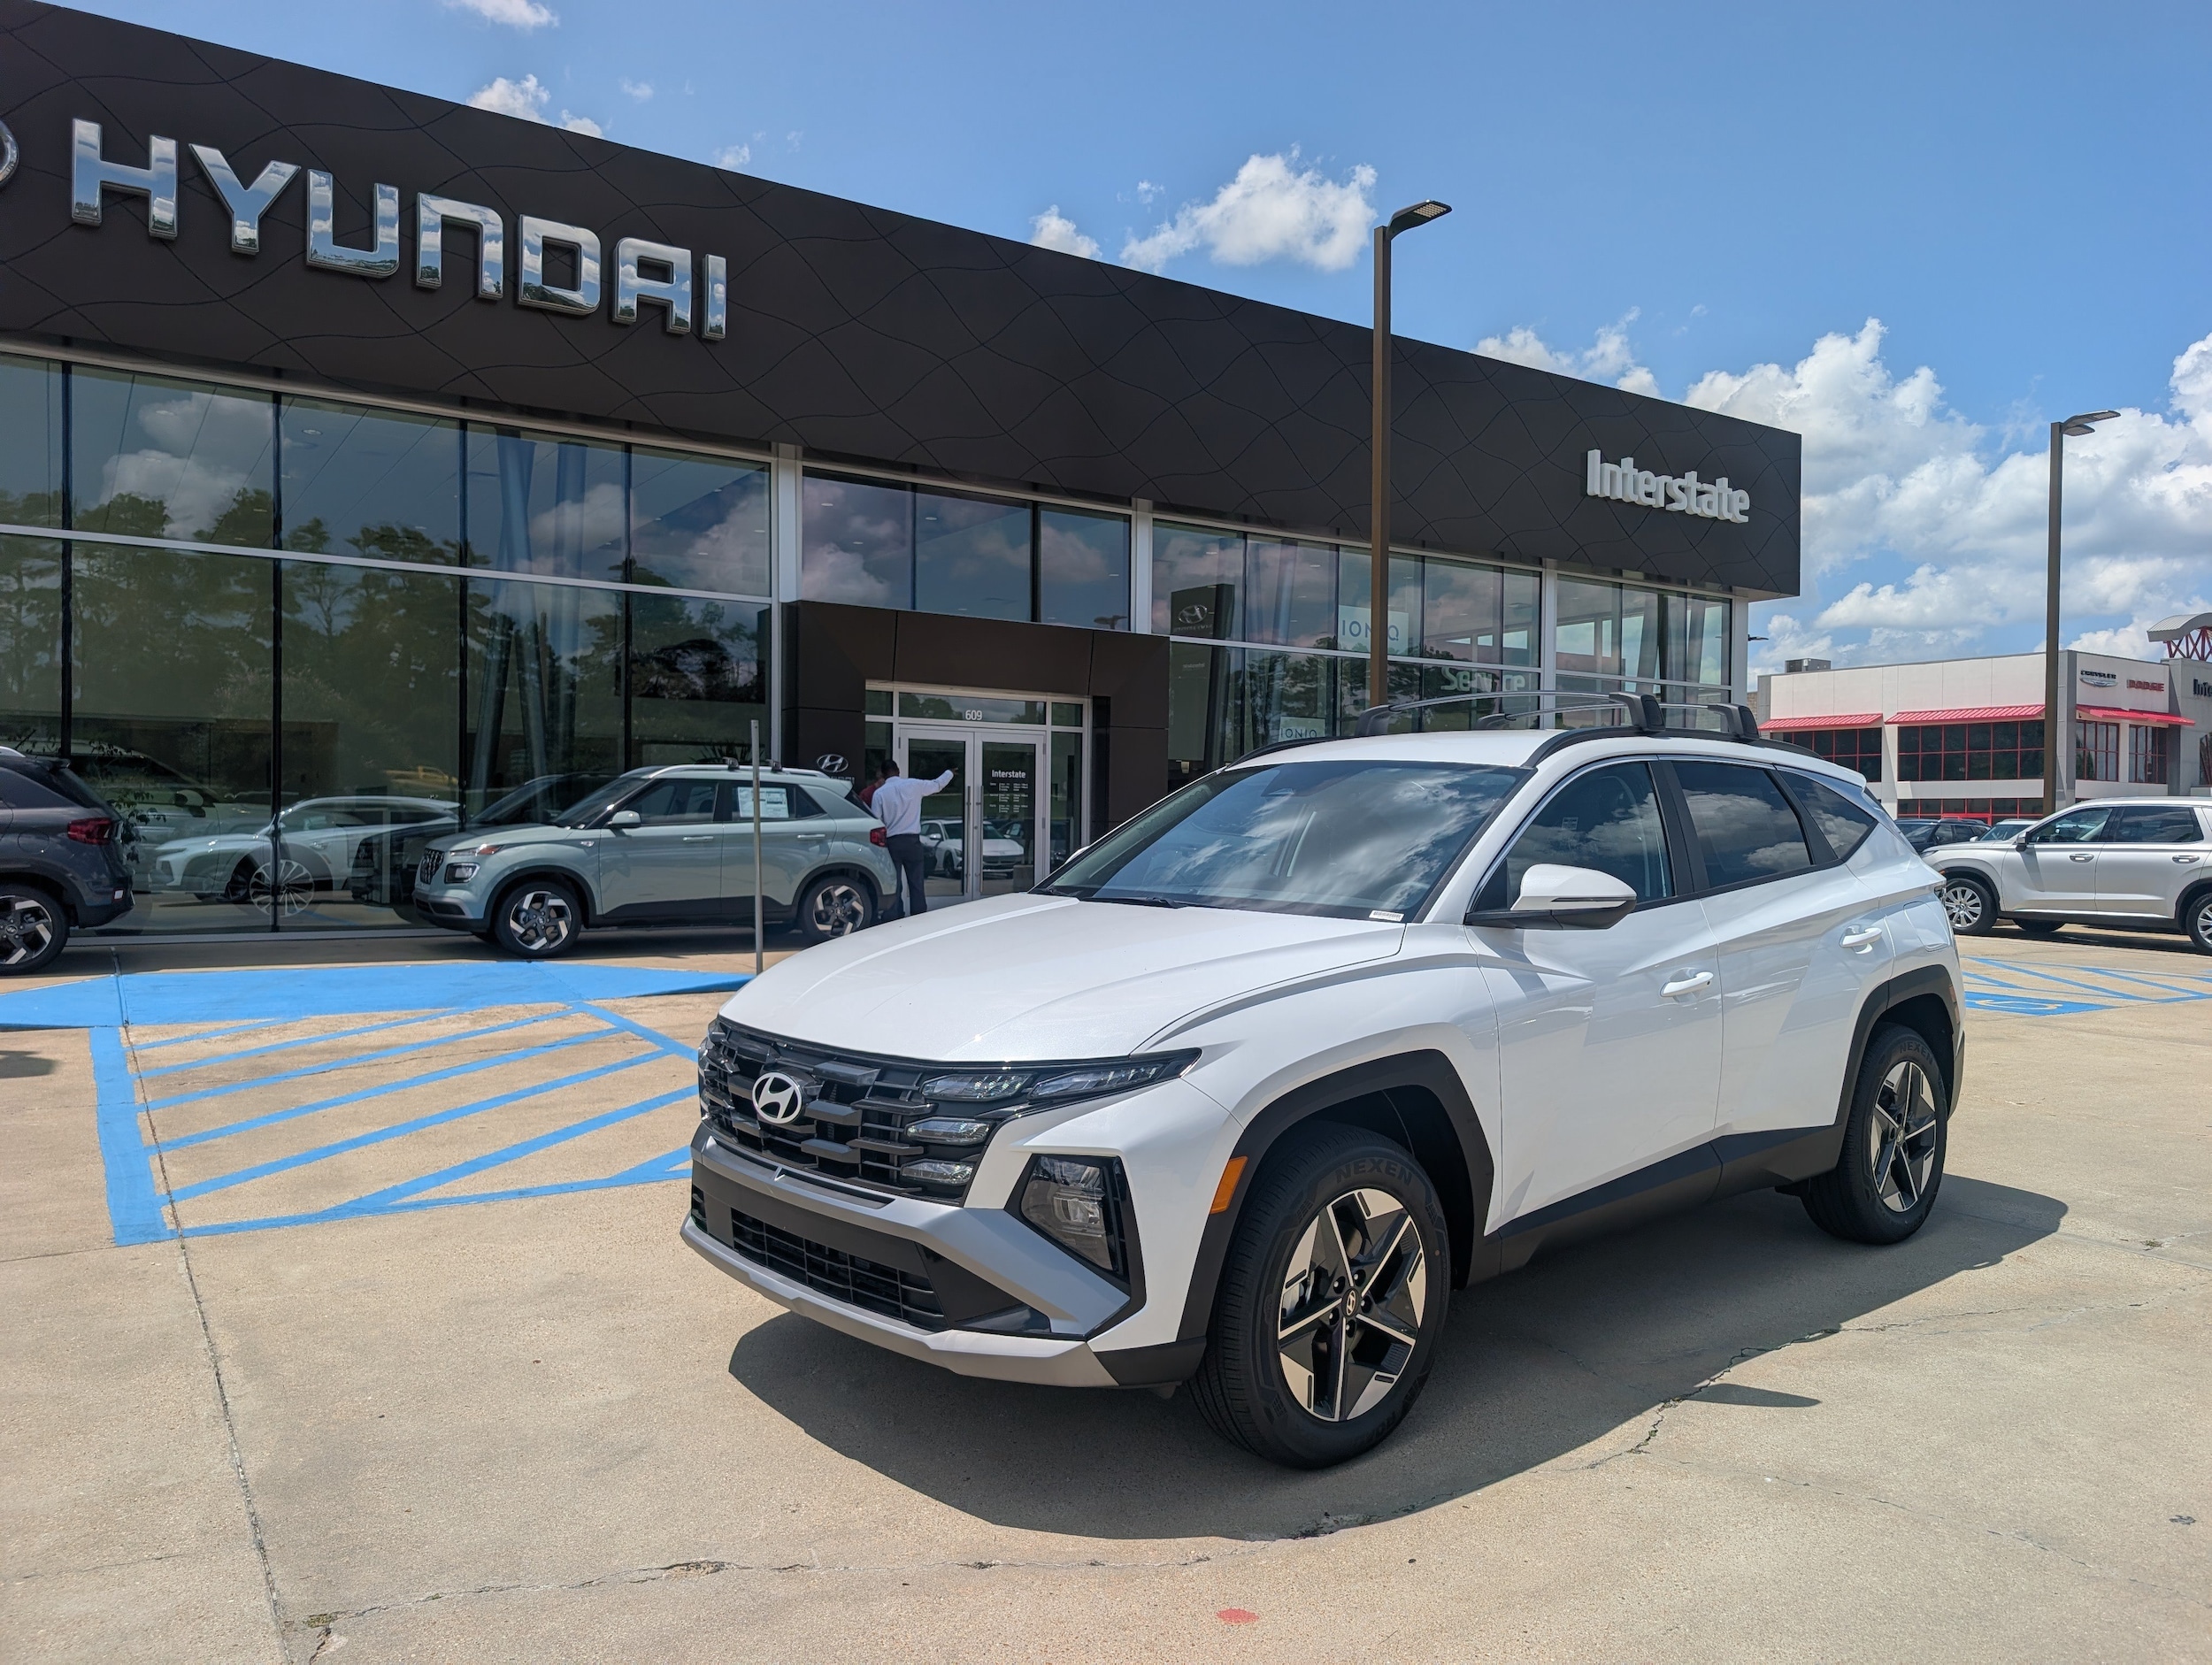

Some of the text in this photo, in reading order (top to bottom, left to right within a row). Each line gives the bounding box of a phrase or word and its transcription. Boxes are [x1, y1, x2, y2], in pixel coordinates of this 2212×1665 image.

[72, 119, 726, 341] HYUNDAI
[1587, 449, 1750, 524] Interstate
[1342, 619, 1399, 641] IONQ
[2126, 679, 2164, 692] DODGE
[965, 710, 982, 721] 609
[991, 769, 1026, 779] Interstate
[1900, 1041, 1933, 1064] NEXEN
[1335, 1158, 1412, 1185] NEXEN
